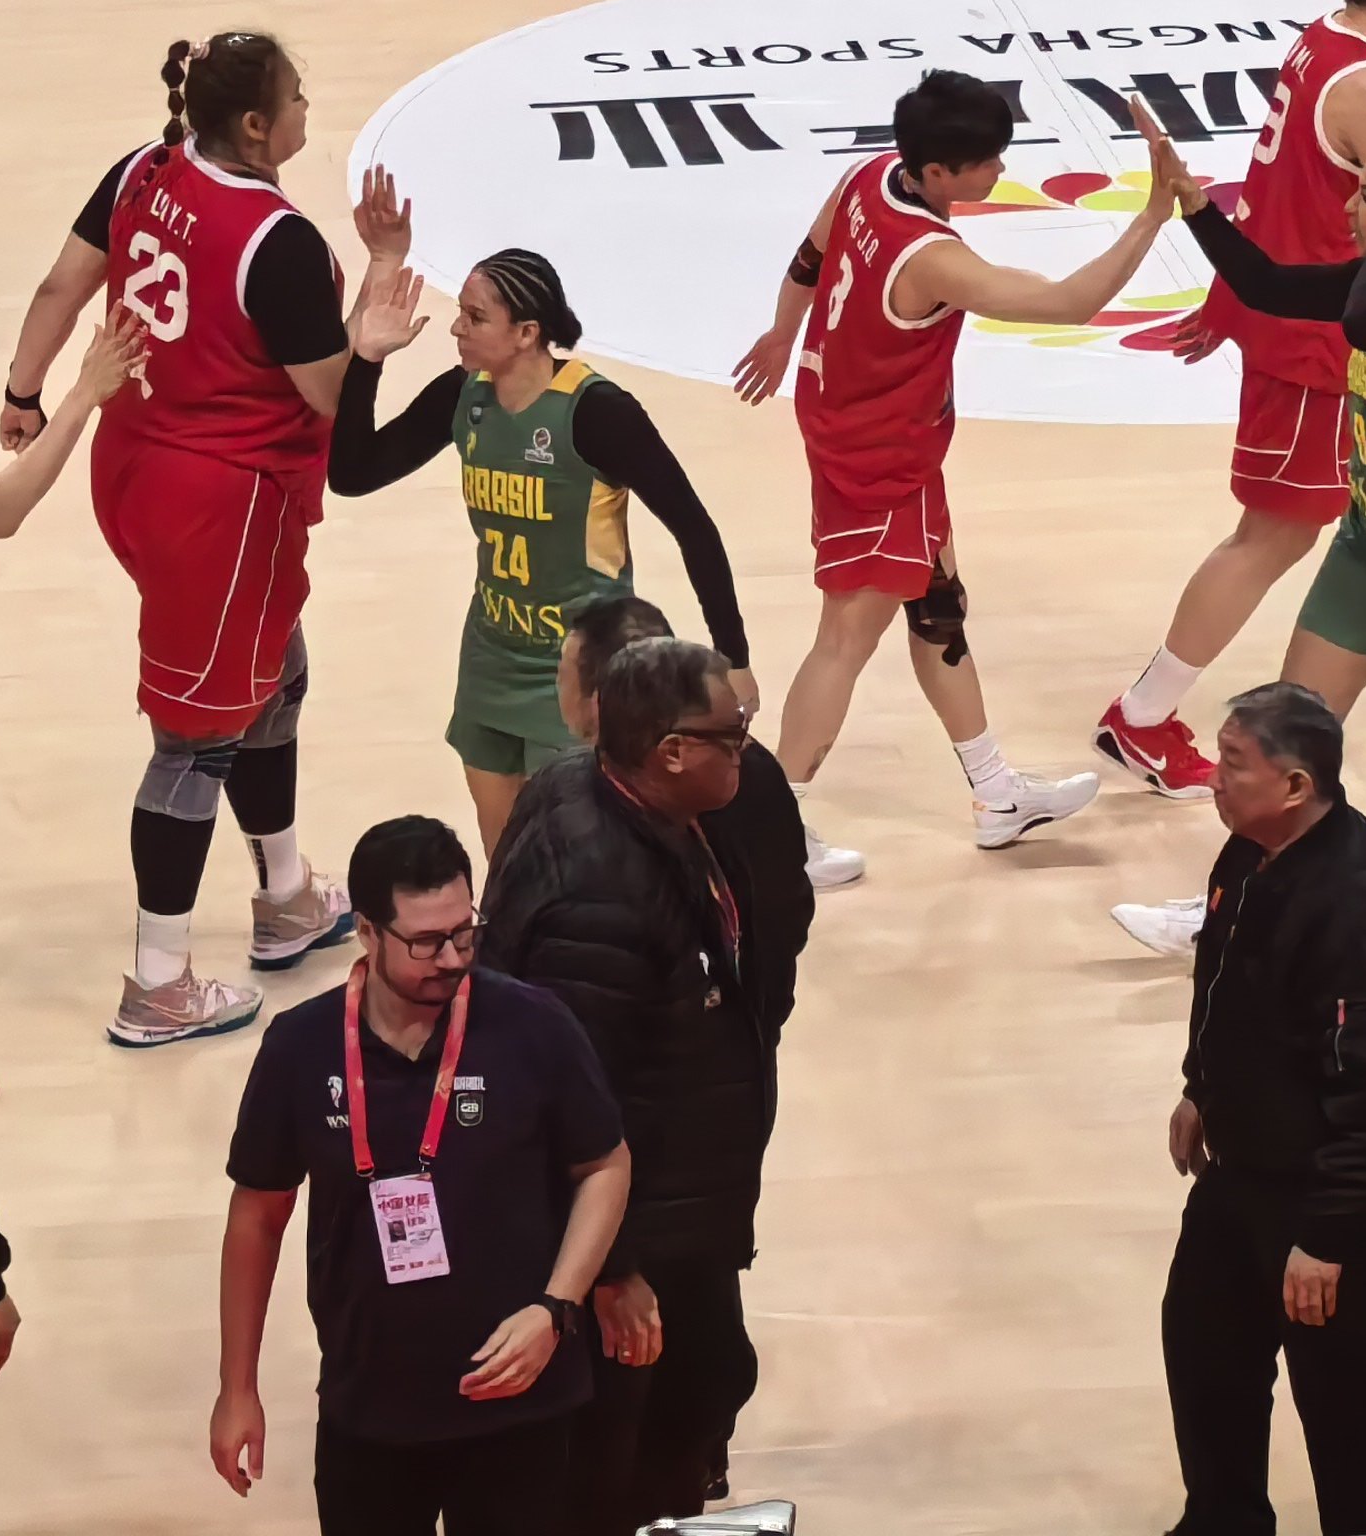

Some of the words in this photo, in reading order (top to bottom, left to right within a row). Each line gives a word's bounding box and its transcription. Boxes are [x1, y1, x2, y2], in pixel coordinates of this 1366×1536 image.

[584, 37, 924, 74] SPORTS
[122, 230, 189, 343] 23
[462, 464, 553, 521] BRASIL
